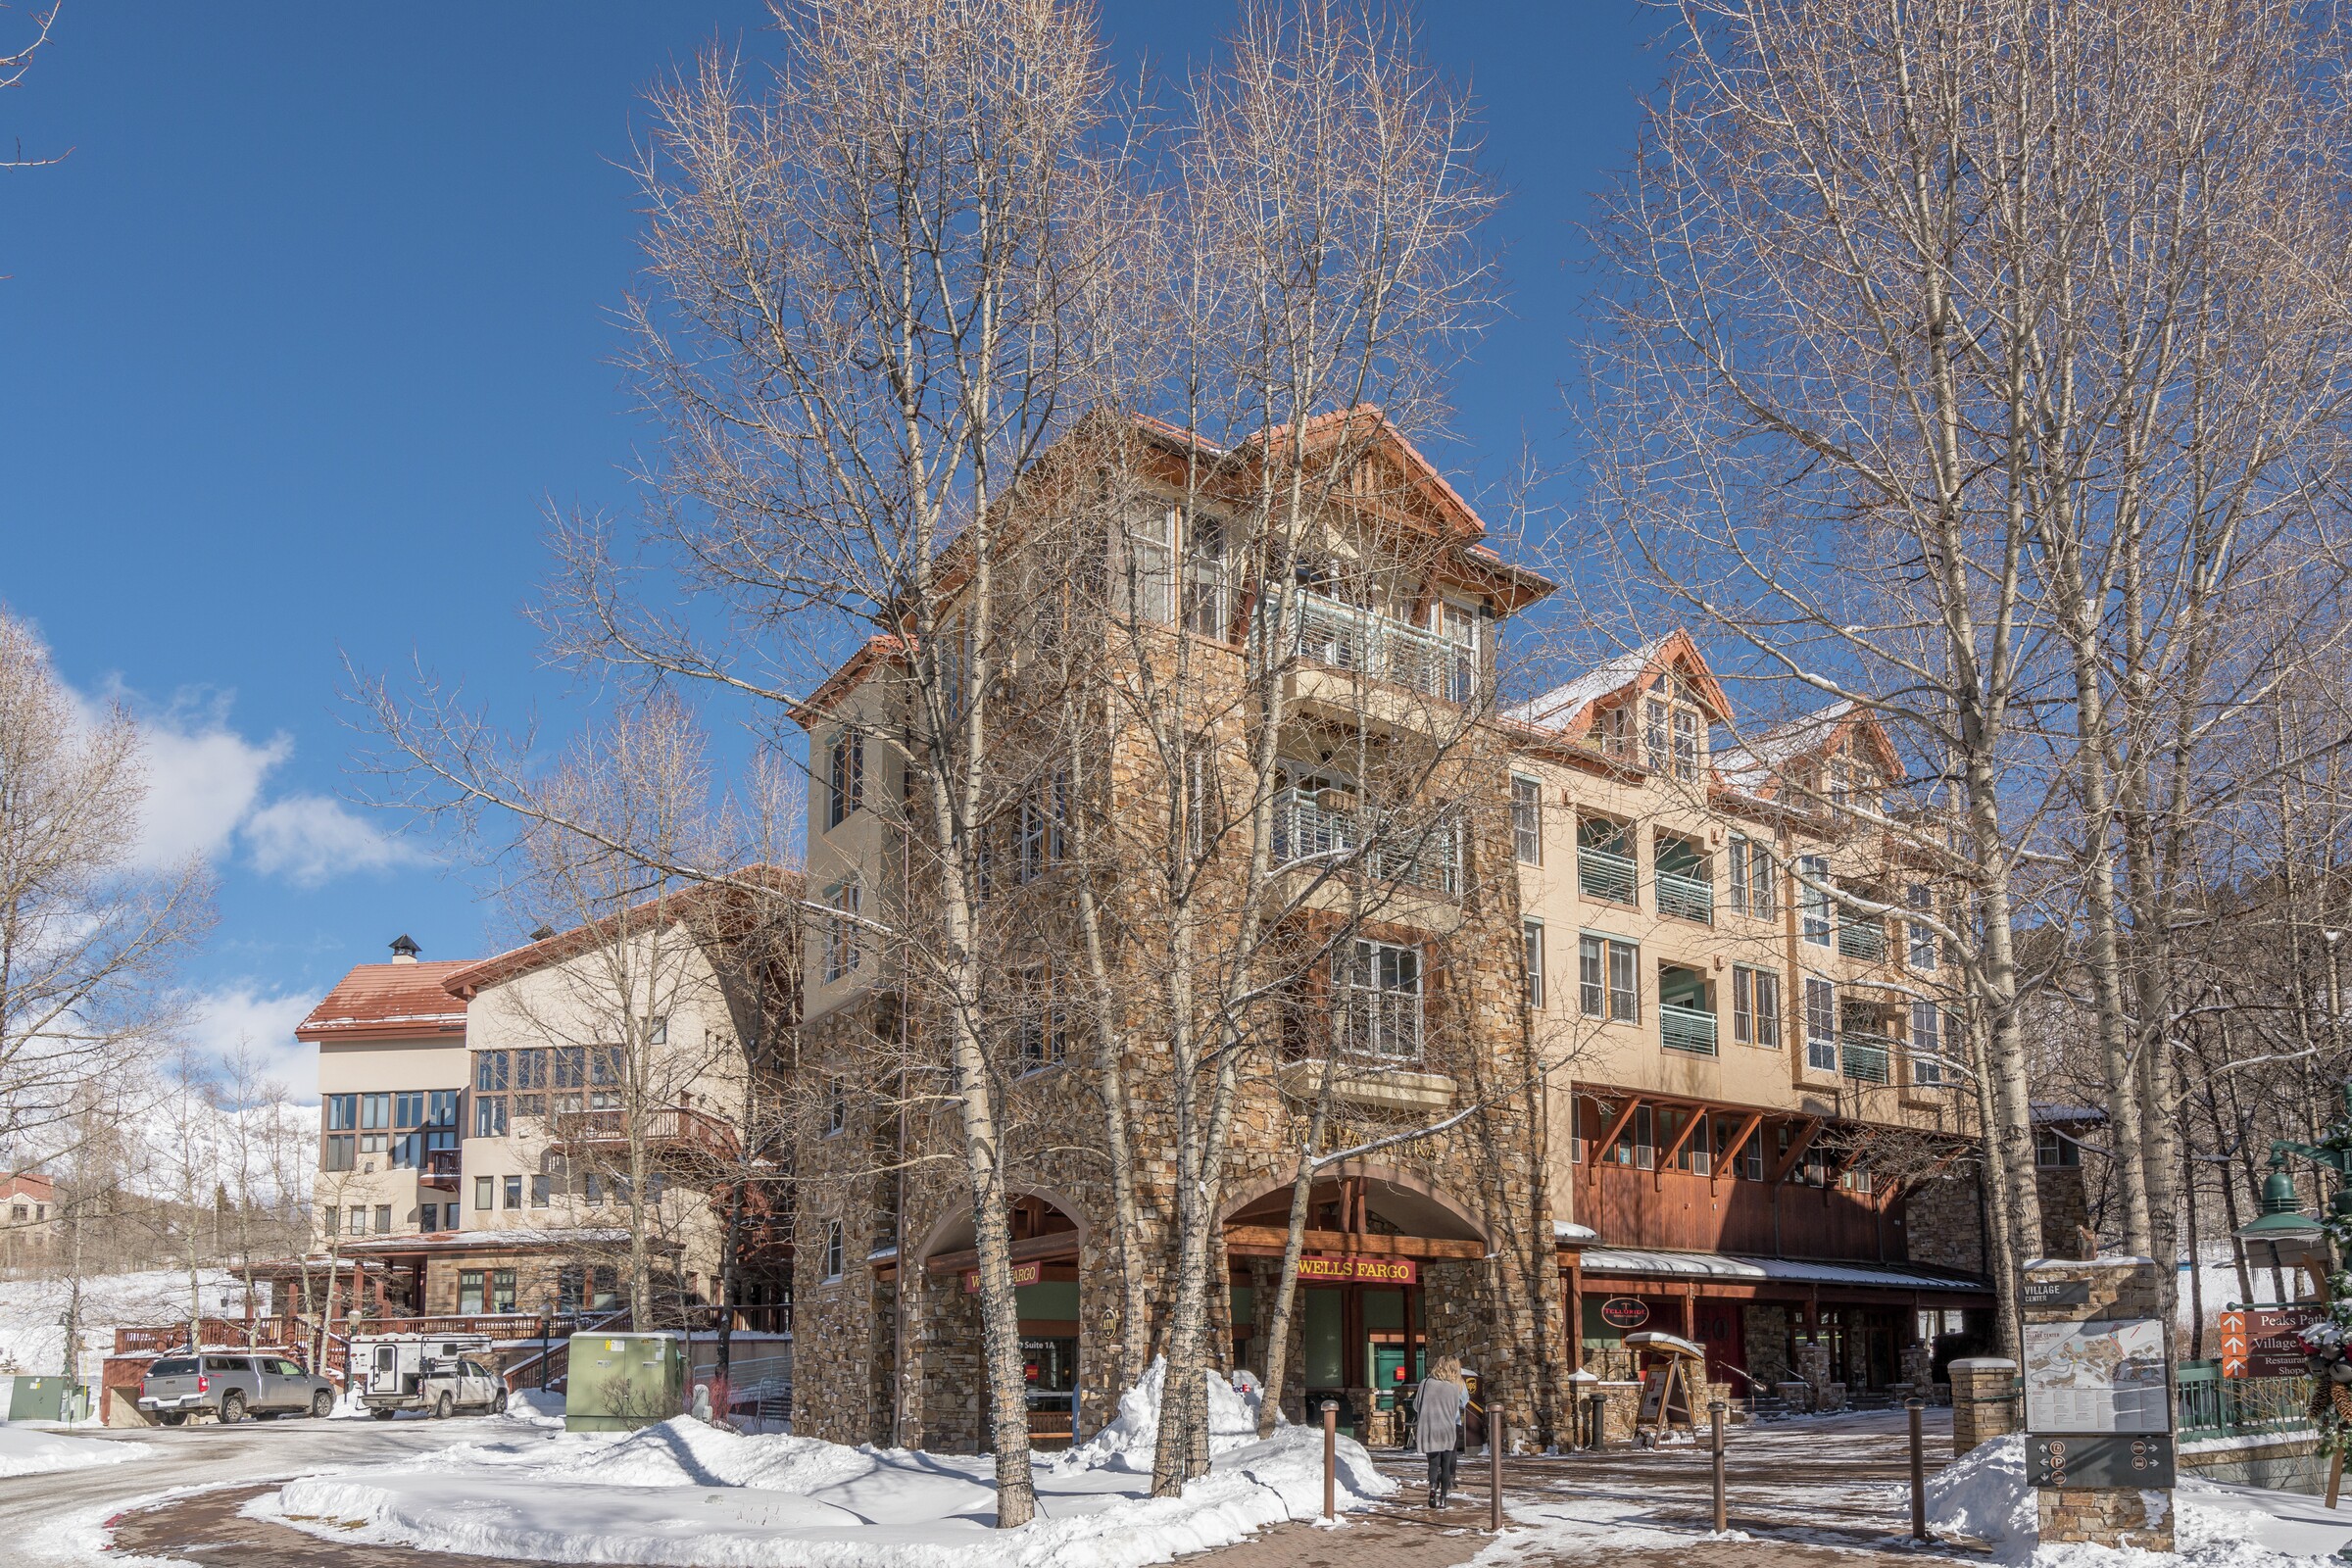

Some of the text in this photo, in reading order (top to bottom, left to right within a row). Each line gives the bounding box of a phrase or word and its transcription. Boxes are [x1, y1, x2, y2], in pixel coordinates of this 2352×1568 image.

[1010, 1266, 1036, 1283] ARGO
[1298, 1260, 1409, 1279] WELLS FARGO
[2024, 1285, 2060, 1295] VILLAGE
[1102, 1319, 1114, 1330] ATM
[2261, 1315, 2296, 1326] Peaks
[2253, 1338, 2297, 1350] Village
[2278, 1366, 2305, 1376] Shops
